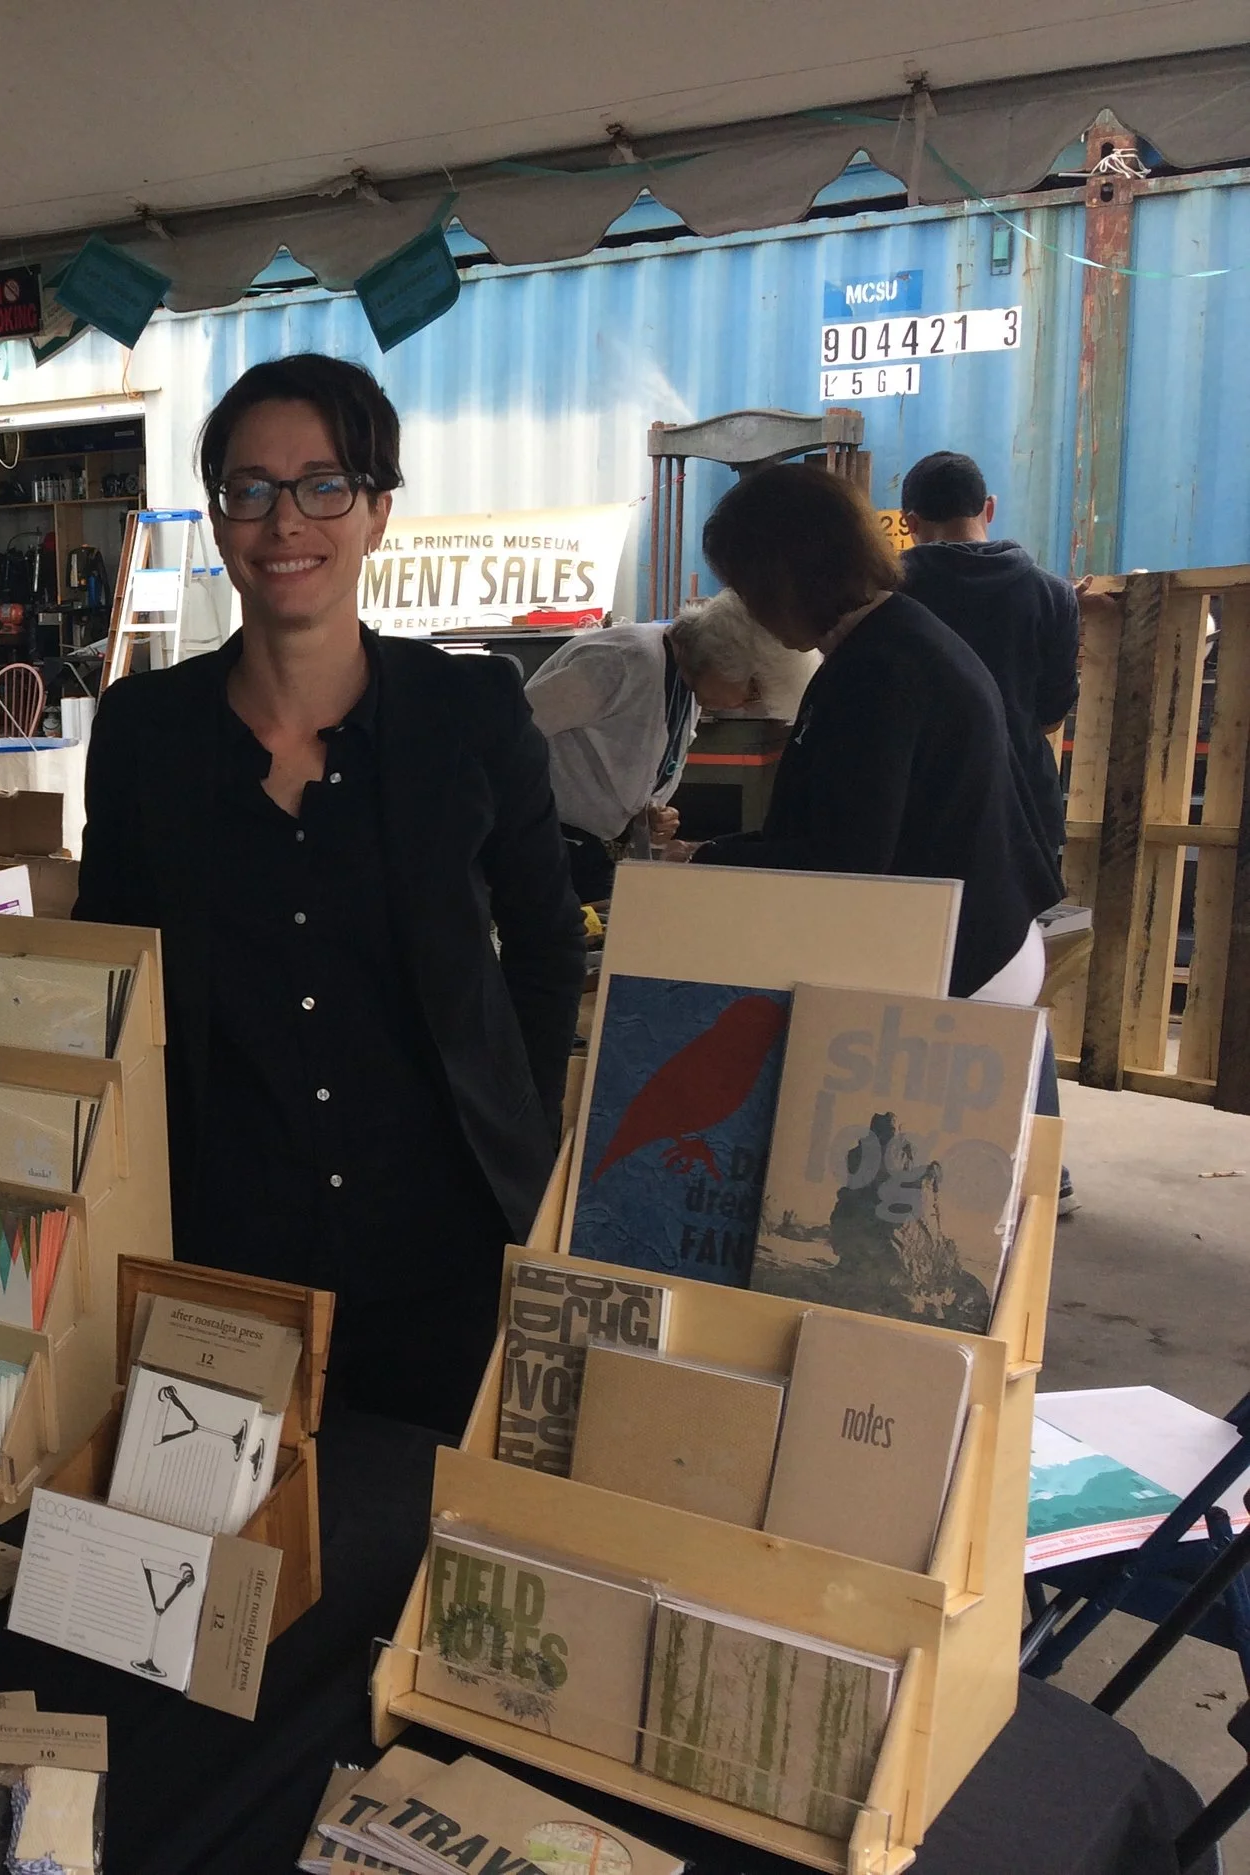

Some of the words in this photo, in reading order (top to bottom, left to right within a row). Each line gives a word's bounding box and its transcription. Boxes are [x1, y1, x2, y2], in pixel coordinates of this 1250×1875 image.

[845, 280, 898, 304] MCSU
[823, 314, 968, 363] 904421
[413, 535, 494, 549] PRINTING
[503, 535, 579, 552] MUSEUM
[479, 555, 595, 606] SALES
[394, 616, 472, 629] BENEFIT
[823, 1005, 1006, 1133] ship
[805, 1092, 935, 1224] log
[170, 1308, 194, 1322] after
[195, 1316, 238, 1334] nostalgia
[238, 1326, 265, 1340] press
[200, 1352, 215, 1365] 12
[840, 1403, 895, 1450] notes
[253, 1568, 268, 1600] after
[430, 1545, 547, 1627] FIELD
[242, 1601, 261, 1657] nostalgia
[237, 1660, 251, 1693] press
[21, 1725, 71, 1737] nostalgia
